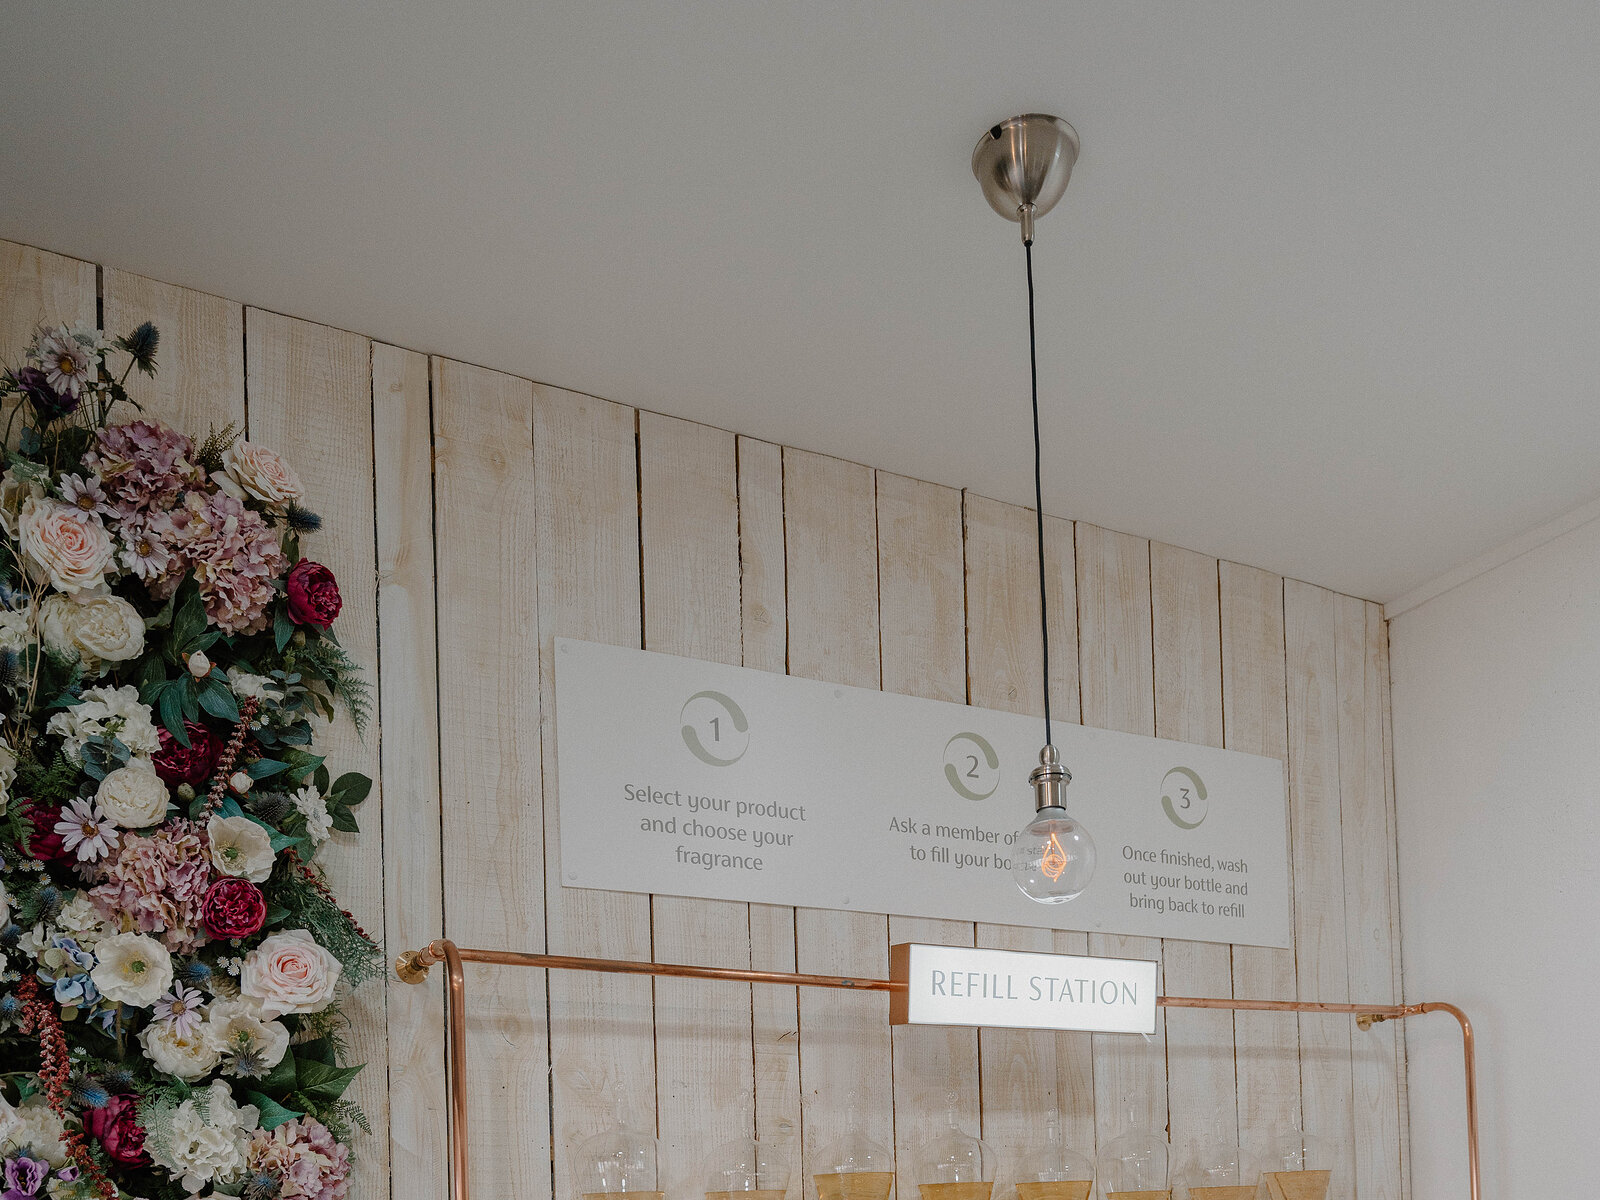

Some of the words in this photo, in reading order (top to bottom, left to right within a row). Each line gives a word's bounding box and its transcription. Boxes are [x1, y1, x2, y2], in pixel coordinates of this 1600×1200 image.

[709, 717, 720, 742] 1
[966, 755, 980, 778] 2
[624, 783, 682, 807] Select
[688, 796, 730, 813] your
[736, 801, 806, 821] product
[1181, 789, 1191, 808] 3
[640, 816, 677, 834] and
[683, 819, 747, 842] choose
[752, 830, 794, 848] your
[889, 816, 917, 834] Ask
[922, 823, 931, 835] a
[936, 825, 1000, 844] member
[1003, 831, 1019, 845] of
[676, 845, 764, 871] fragrance
[910, 845, 926, 861] to
[930, 845, 950, 865] fill
[954, 852, 991, 870] your
[1122, 845, 1156, 863] Once
[1161, 850, 1215, 871] finished,
[1217, 856, 1248, 873] wash
[1123, 871, 1146, 886] out
[1151, 876, 1180, 890] your
[1185, 874, 1221, 893] bottle
[1225, 880, 1248, 896] and
[1130, 893, 1165, 914] bring
[1168, 897, 1198, 914] back
[1201, 900, 1215, 915] to
[1218, 902, 1245, 918] refill
[932, 970, 1018, 999] REFILL
[1029, 976, 1138, 1006] STATION
